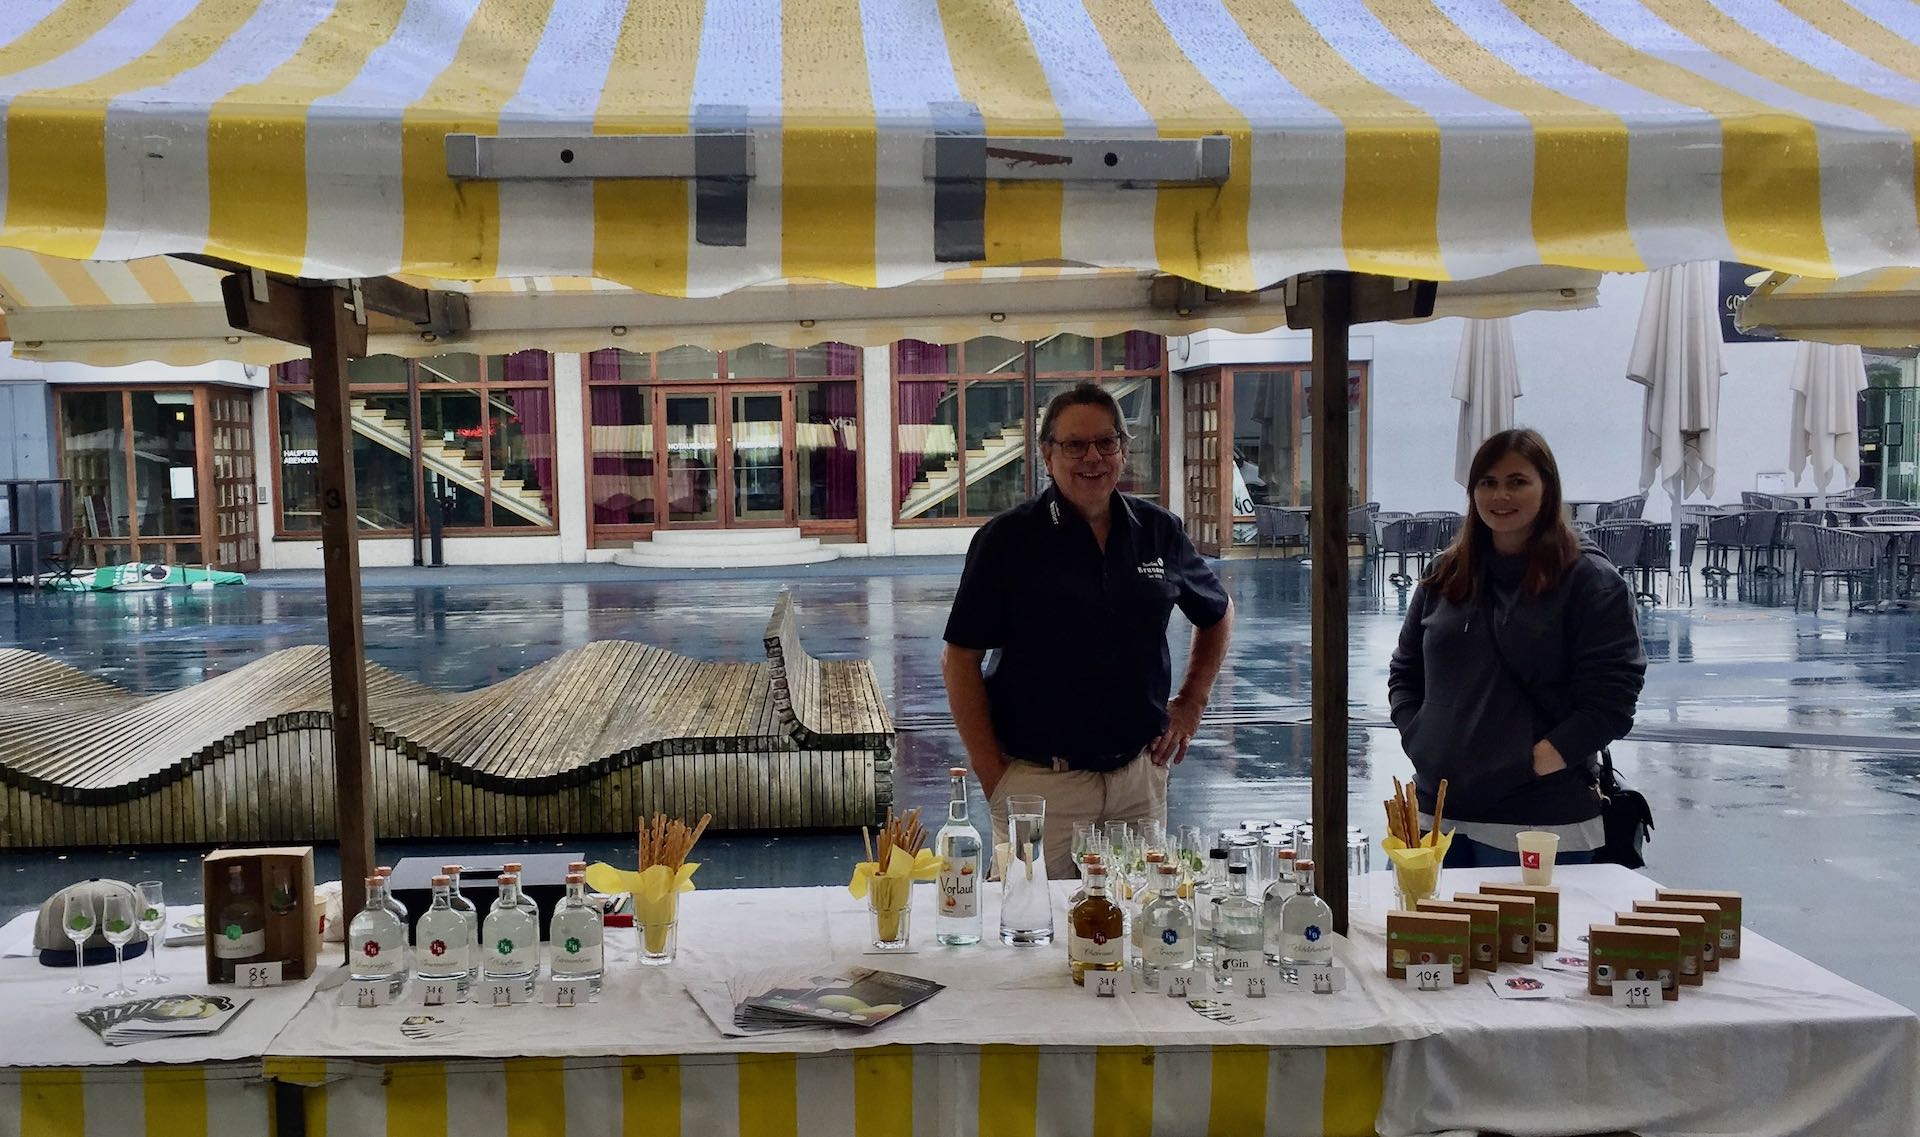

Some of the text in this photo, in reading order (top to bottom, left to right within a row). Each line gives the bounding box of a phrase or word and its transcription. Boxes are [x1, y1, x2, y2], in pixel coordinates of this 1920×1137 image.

[326, 488, 341, 509] 3
[1231, 959, 1249, 968] Gin
[1416, 970, 1441, 982] 10€
[1625, 986, 1651, 998] 15€
